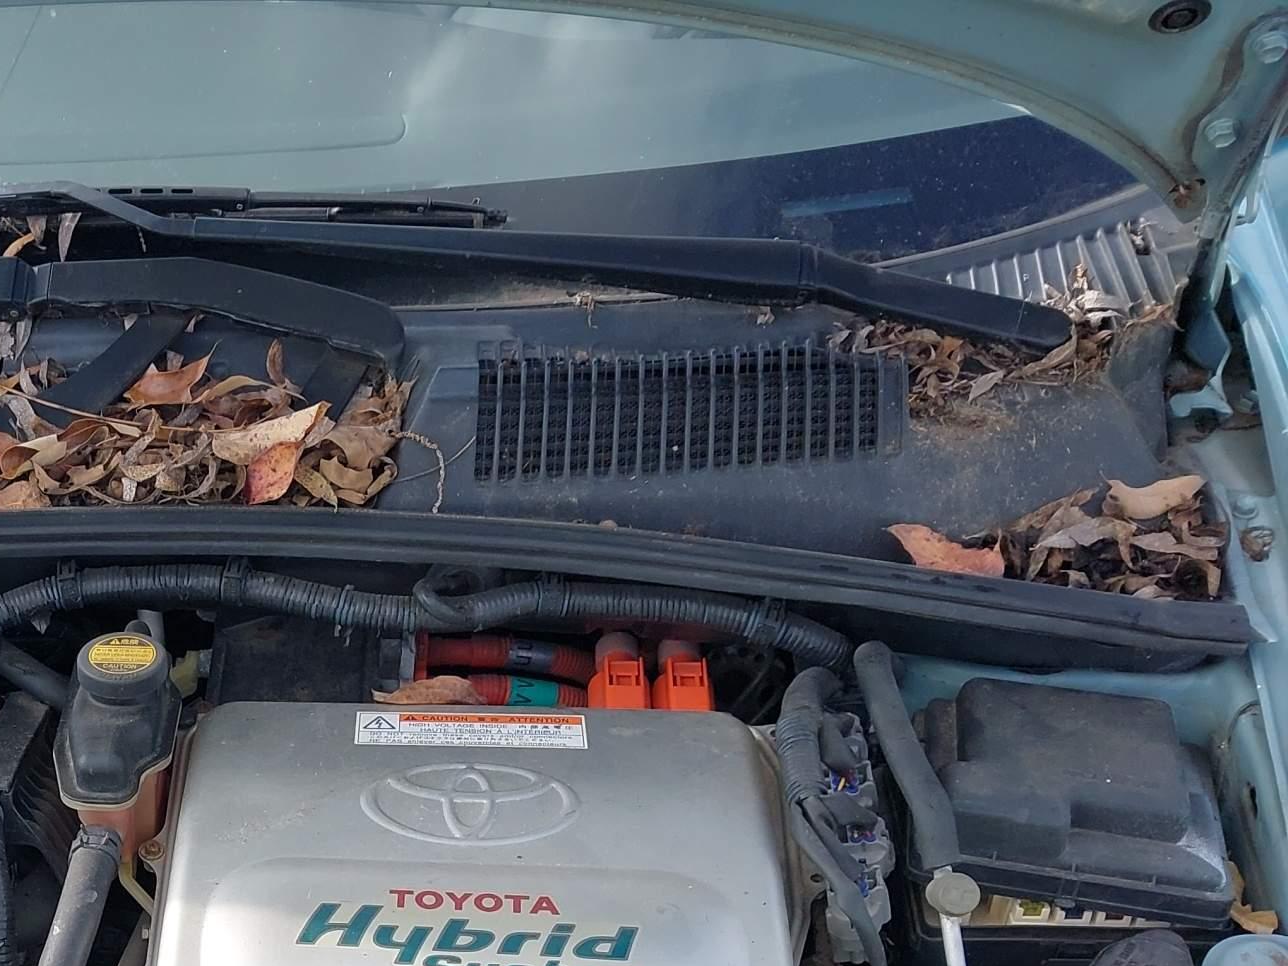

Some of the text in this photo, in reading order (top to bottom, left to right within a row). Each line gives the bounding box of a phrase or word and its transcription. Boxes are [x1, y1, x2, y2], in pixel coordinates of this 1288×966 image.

[422, 714, 468, 722] CAUTION
[389, 888, 560, 916] TOYOTA
[295, 901, 641, 966] Hybrid
